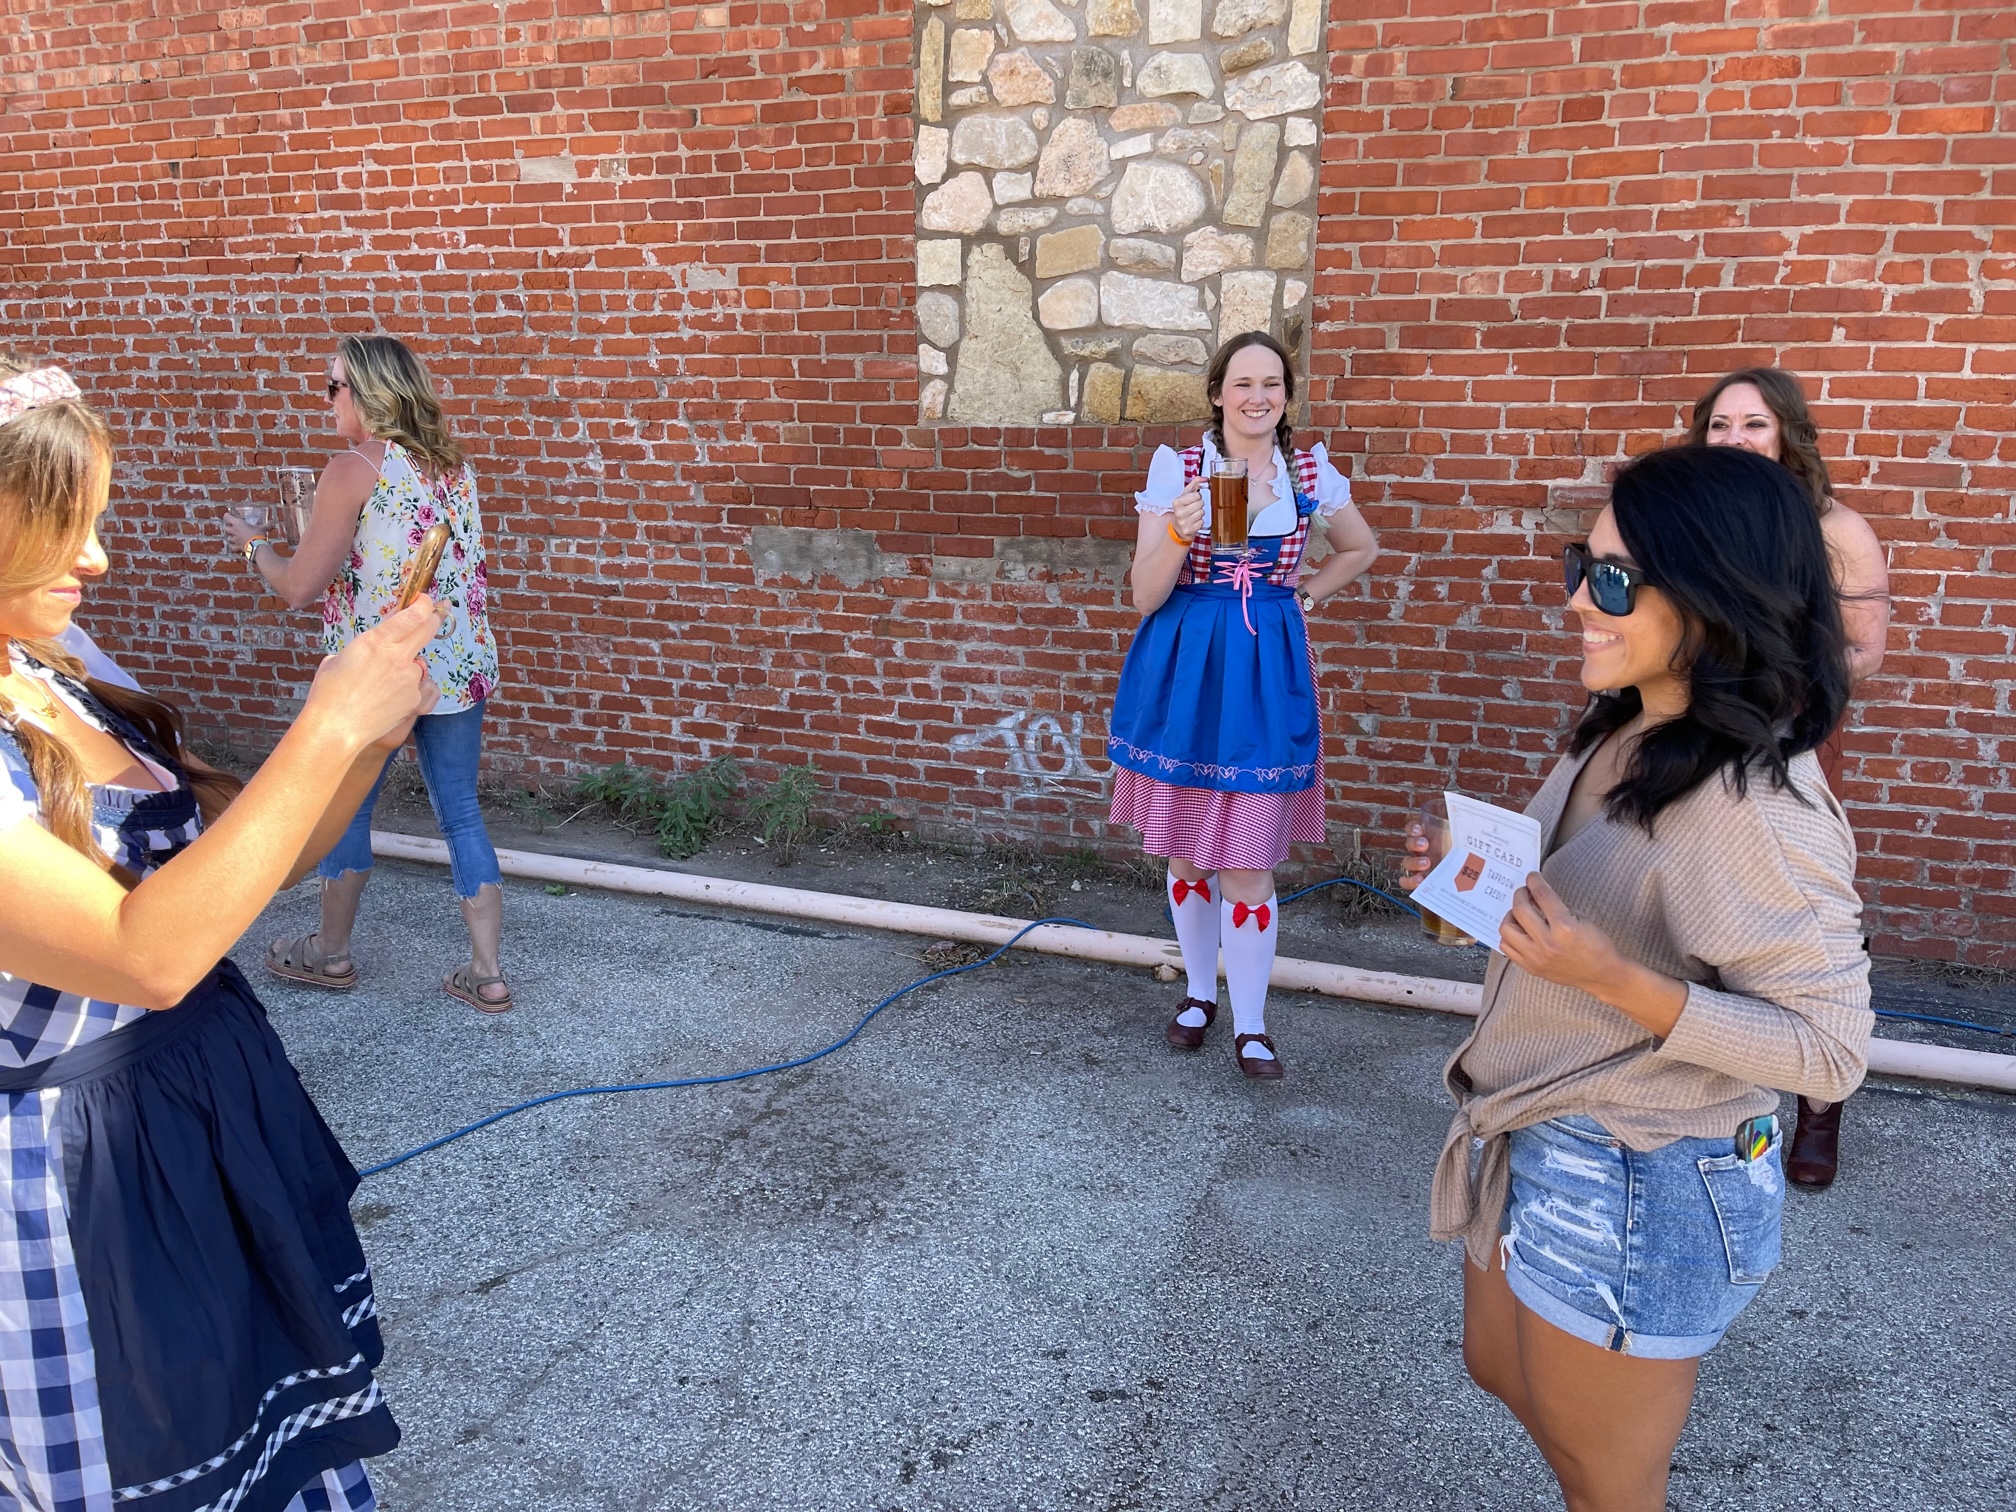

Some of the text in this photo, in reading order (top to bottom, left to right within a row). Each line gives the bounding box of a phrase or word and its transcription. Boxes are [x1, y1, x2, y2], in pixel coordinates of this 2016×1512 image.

[1466, 835, 1491, 854] GIFT
[1494, 847, 1523, 868] CARD
[1461, 865, 1480, 881] $25
[1487, 869, 1516, 888] TAPROOM
[1484, 885, 1507, 902] CREDIT
